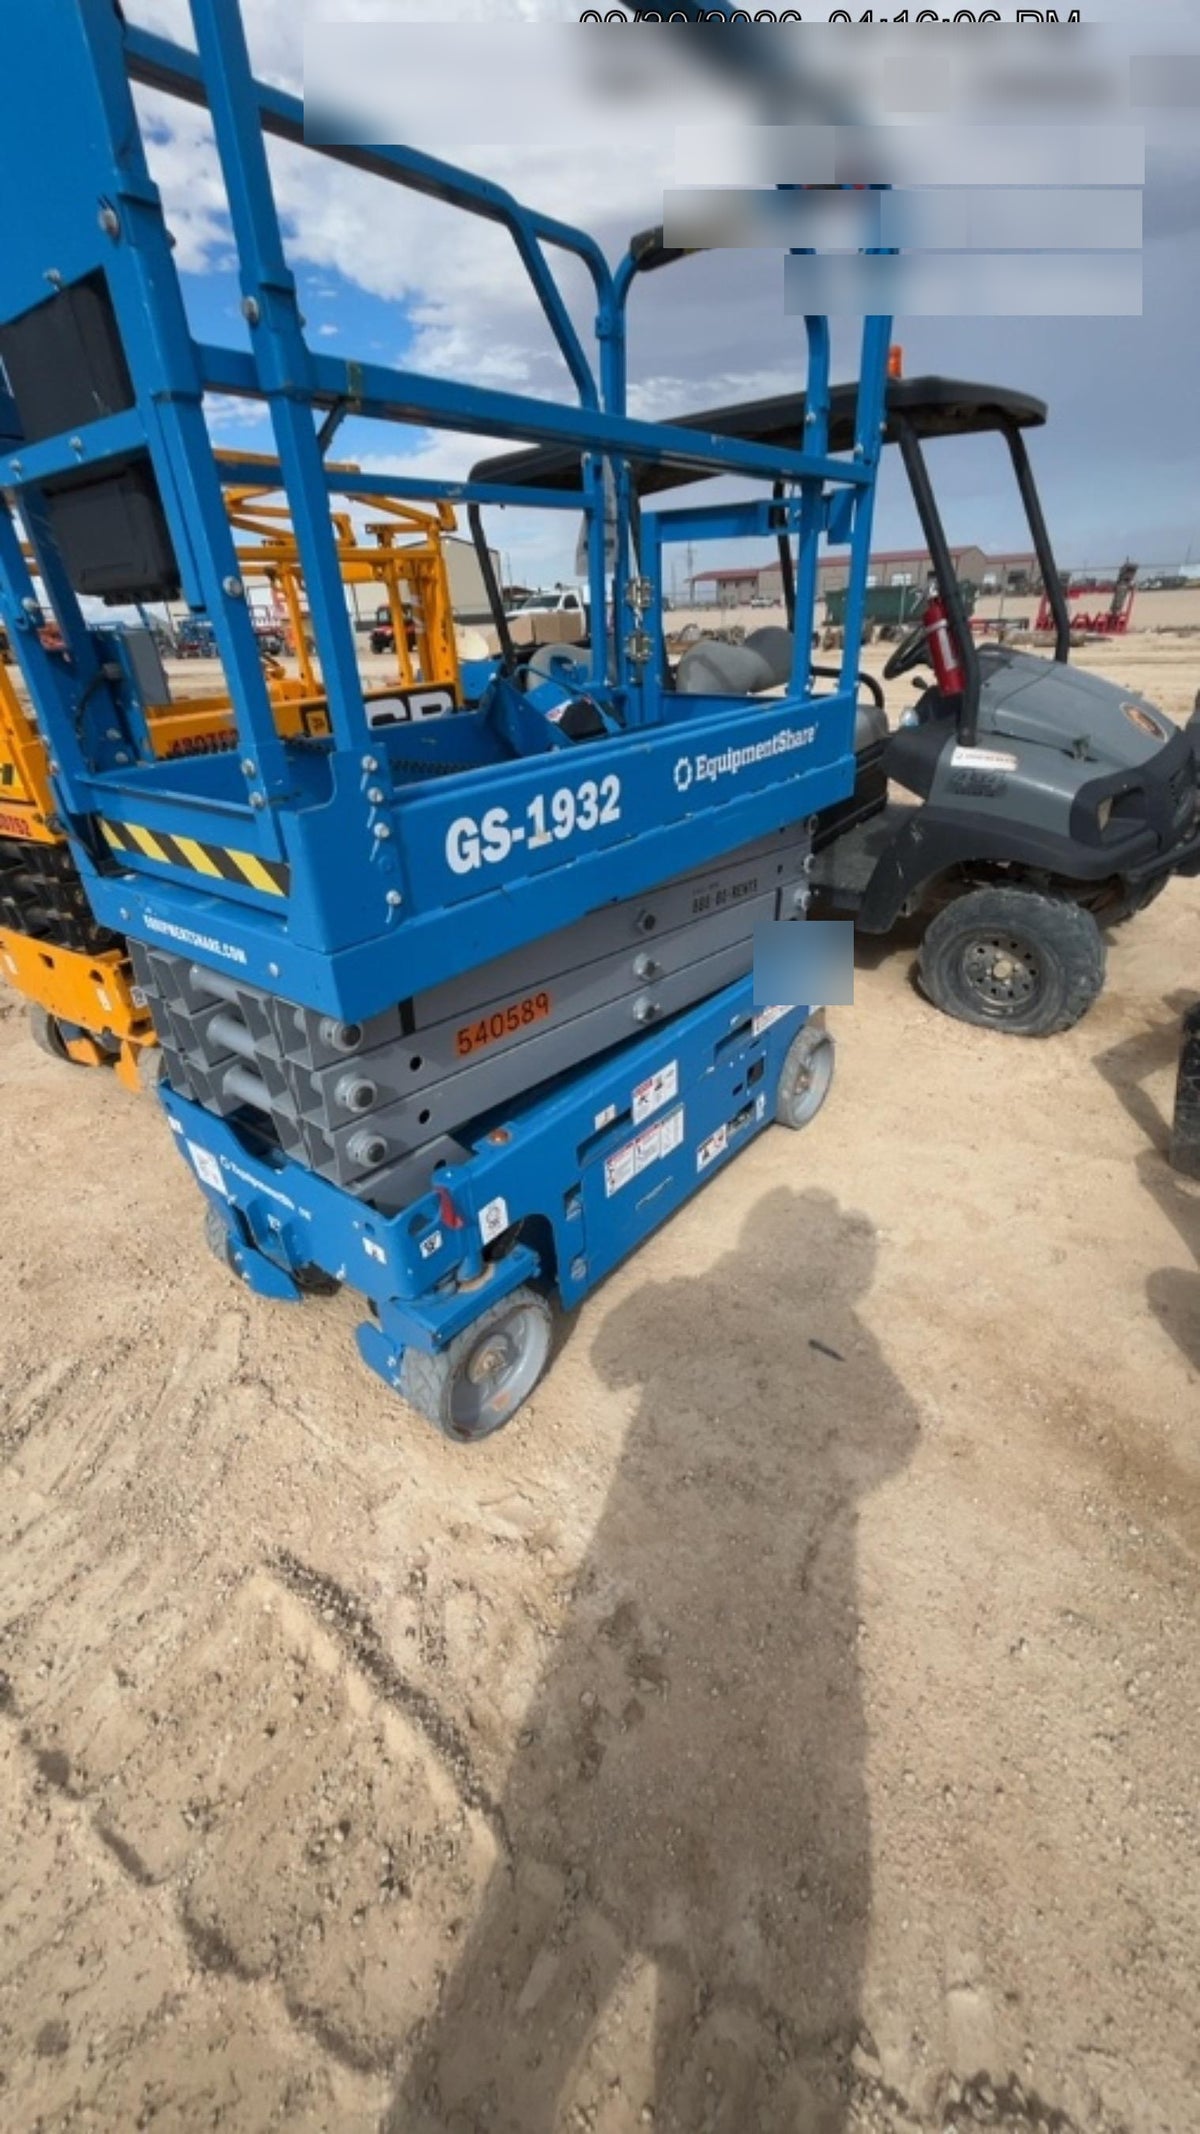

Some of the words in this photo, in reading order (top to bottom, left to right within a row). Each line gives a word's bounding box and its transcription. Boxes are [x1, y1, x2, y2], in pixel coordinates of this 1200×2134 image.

[695, 725, 815, 782] EquipmentShare
[445, 774, 621, 874] GS-1932
[457, 992, 549, 1054] 540589
